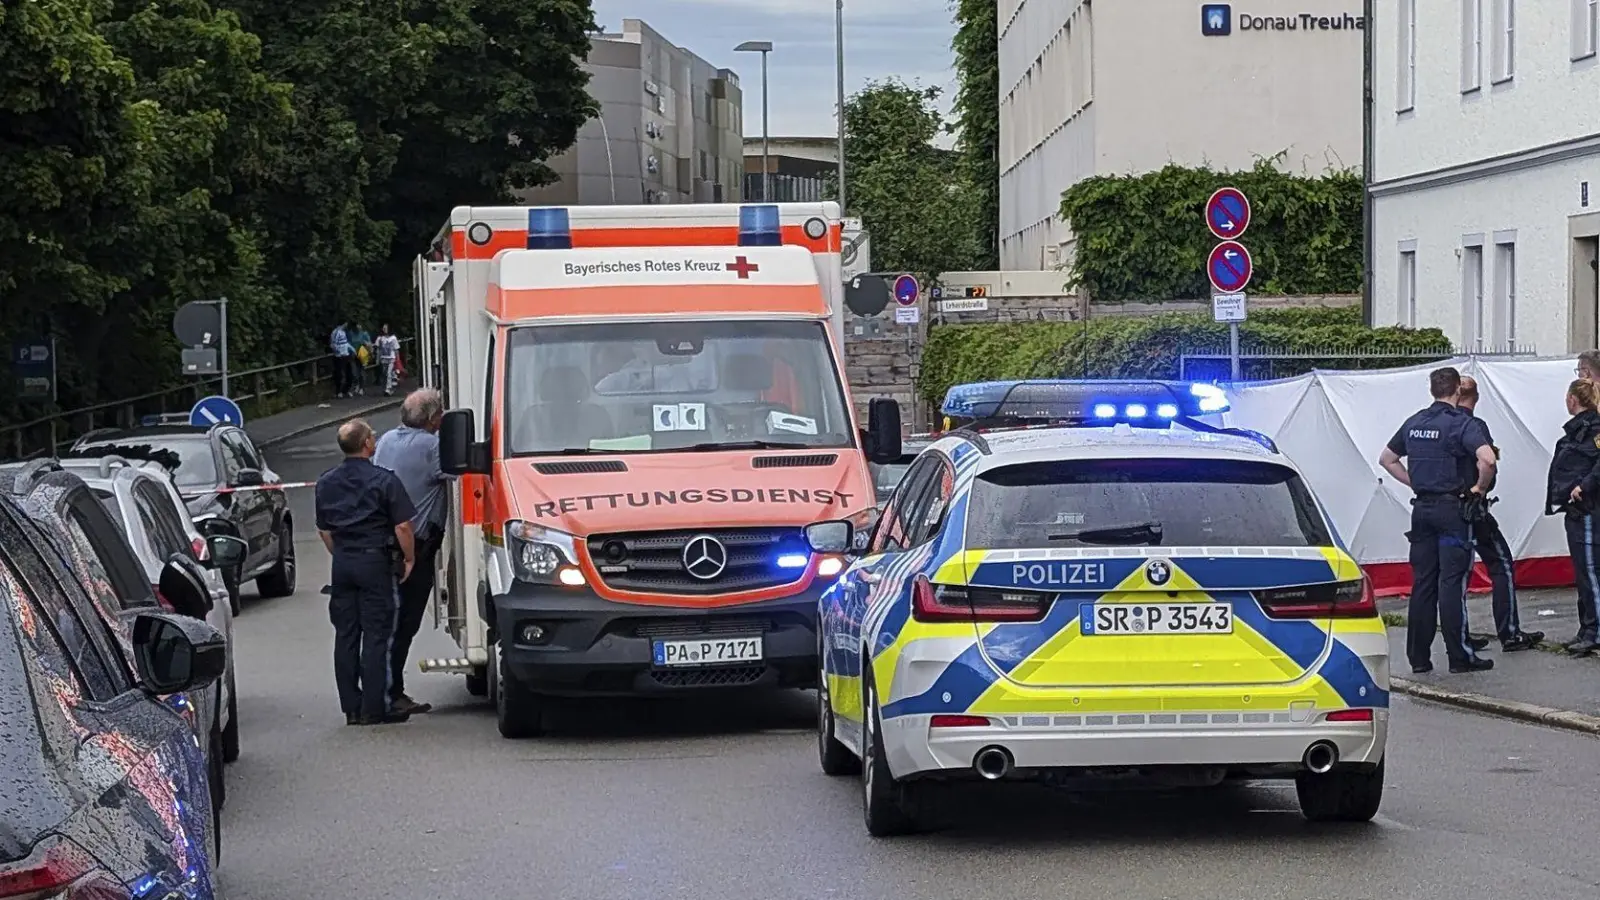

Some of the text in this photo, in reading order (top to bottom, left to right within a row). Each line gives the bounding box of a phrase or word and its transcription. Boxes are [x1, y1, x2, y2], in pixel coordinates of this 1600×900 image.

[564, 259, 721, 276] Bayerisches Rotes Kreuz
[1409, 429, 1440, 439] POLIZEI
[533, 488, 854, 518] RETTUNGSDIENST
[1012, 563, 1105, 585] POLIZEI
[1097, 607, 1129, 631] SR
[1146, 606, 1162, 630] P
[1167, 606, 1229, 630] 3543
[665, 644, 689, 662] PA
[701, 643, 712, 660] P
[715, 640, 759, 660] 7171
